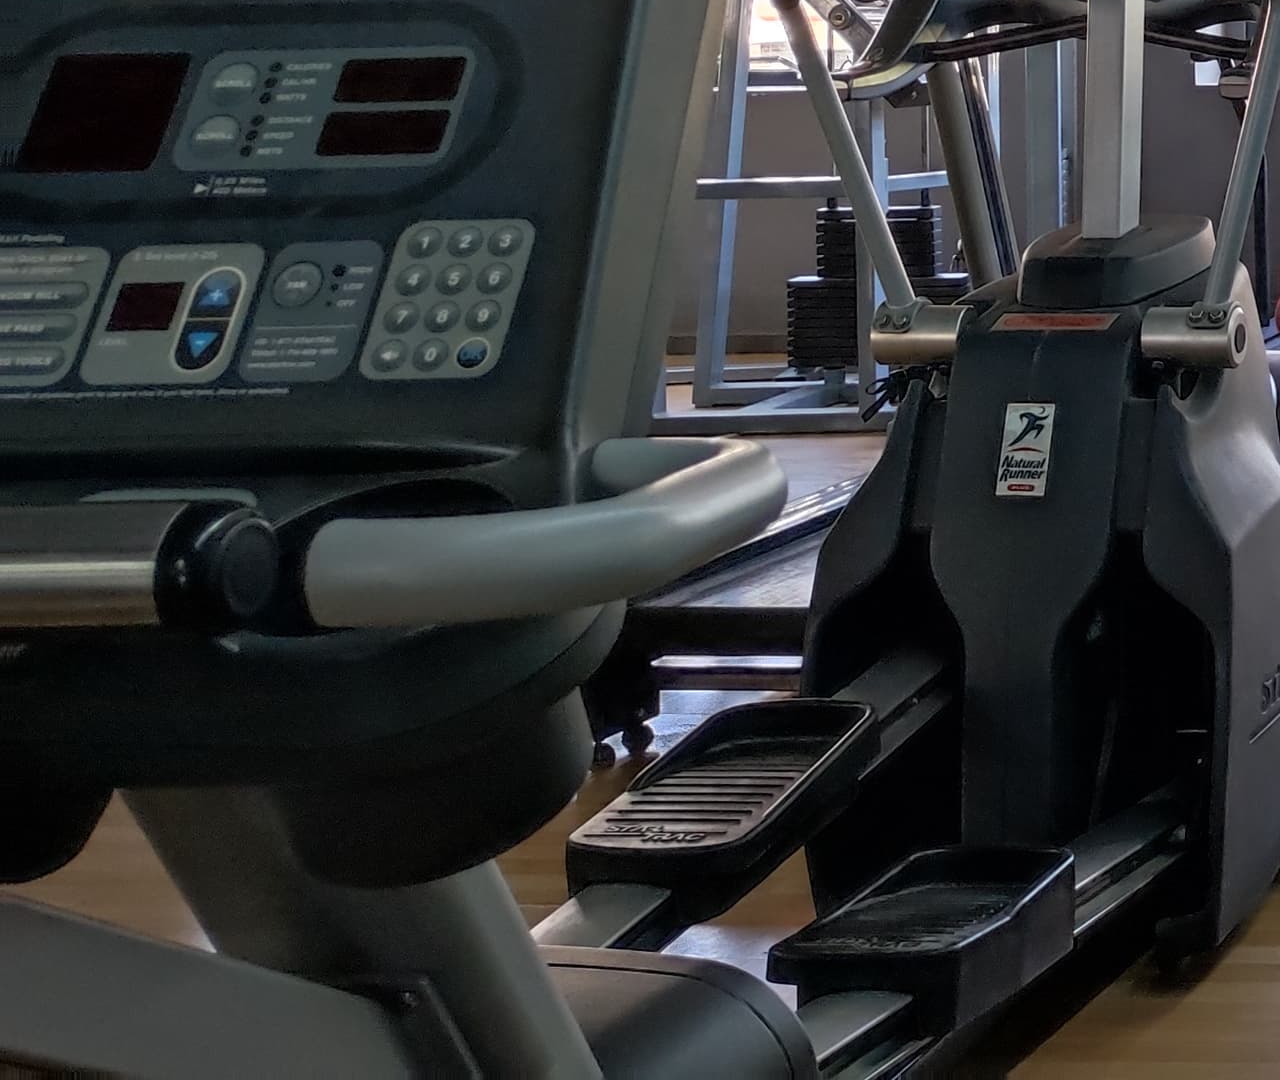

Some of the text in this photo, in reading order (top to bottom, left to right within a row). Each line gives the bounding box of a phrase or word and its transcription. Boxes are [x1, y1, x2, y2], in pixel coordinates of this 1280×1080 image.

[422, 235, 512, 248] 1 2 3
[408, 271, 501, 286] 4 5 6
[397, 309, 489, 324] 7 8 9
[424, 347, 437, 361] 0
[1001, 455, 1047, 469] Natural
[999, 469, 1045, 482] Runner
